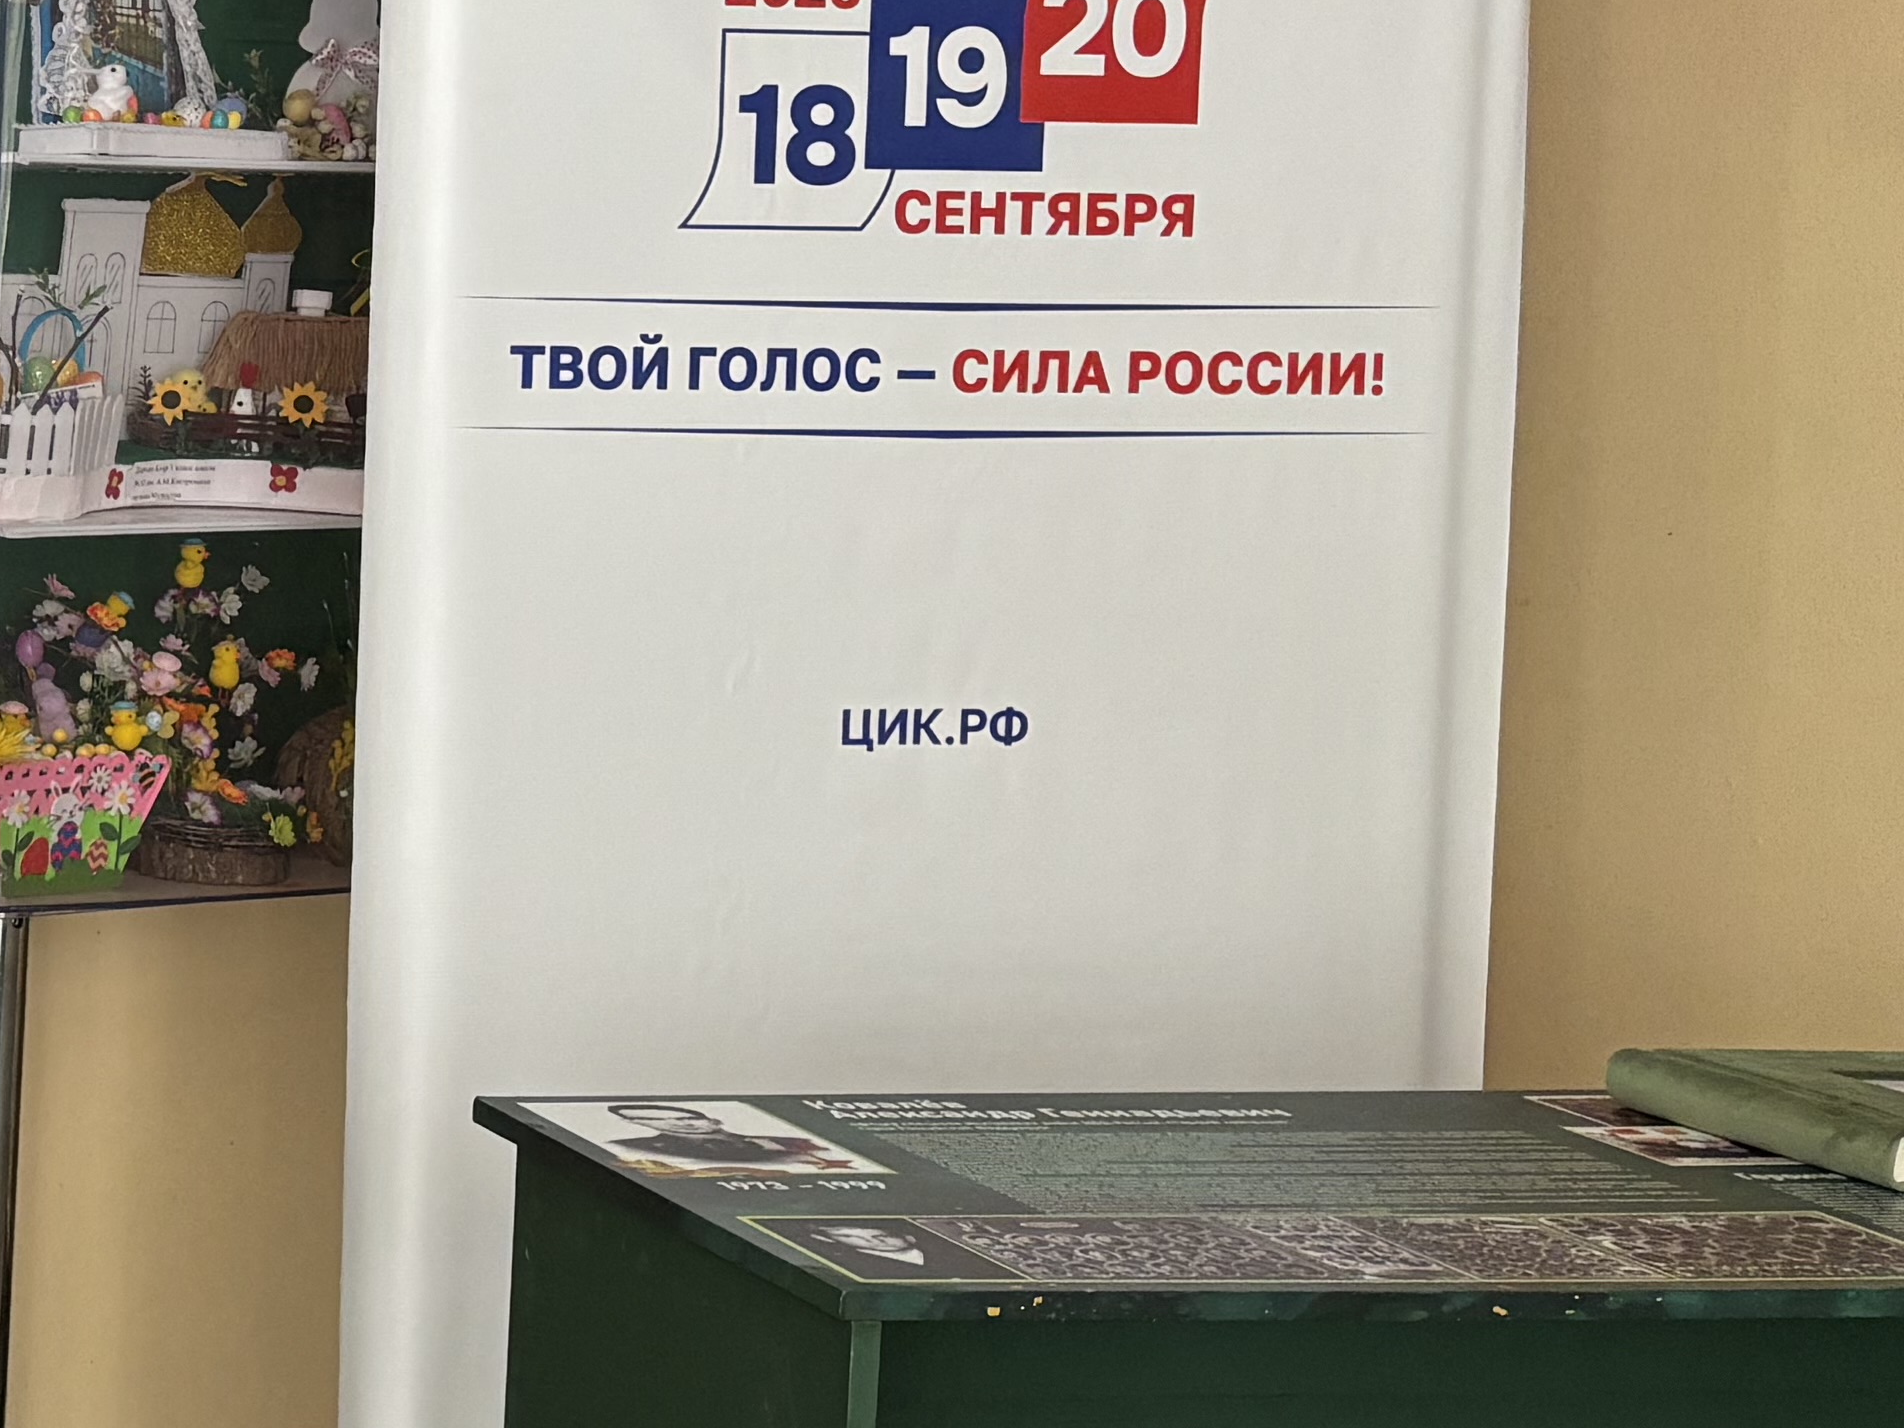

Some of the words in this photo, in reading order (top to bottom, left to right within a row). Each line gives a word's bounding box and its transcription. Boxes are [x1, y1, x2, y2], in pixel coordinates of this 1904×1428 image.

[737, 83, 857, 187] 18
[888, 25, 1008, 129] 19
[893, 189, 1195, 239] СЕНТЯБРЯ
[509, 334, 669, 390] ТВОЙ
[688, 346, 881, 392] ГОЛОС
[952, 349, 1110, 394] СИЛА
[1127, 351, 1384, 395] РОССИИ!
[841, 708, 1029, 750] ЦИК.РФ
[829, 1109, 1037, 1123] Александр
